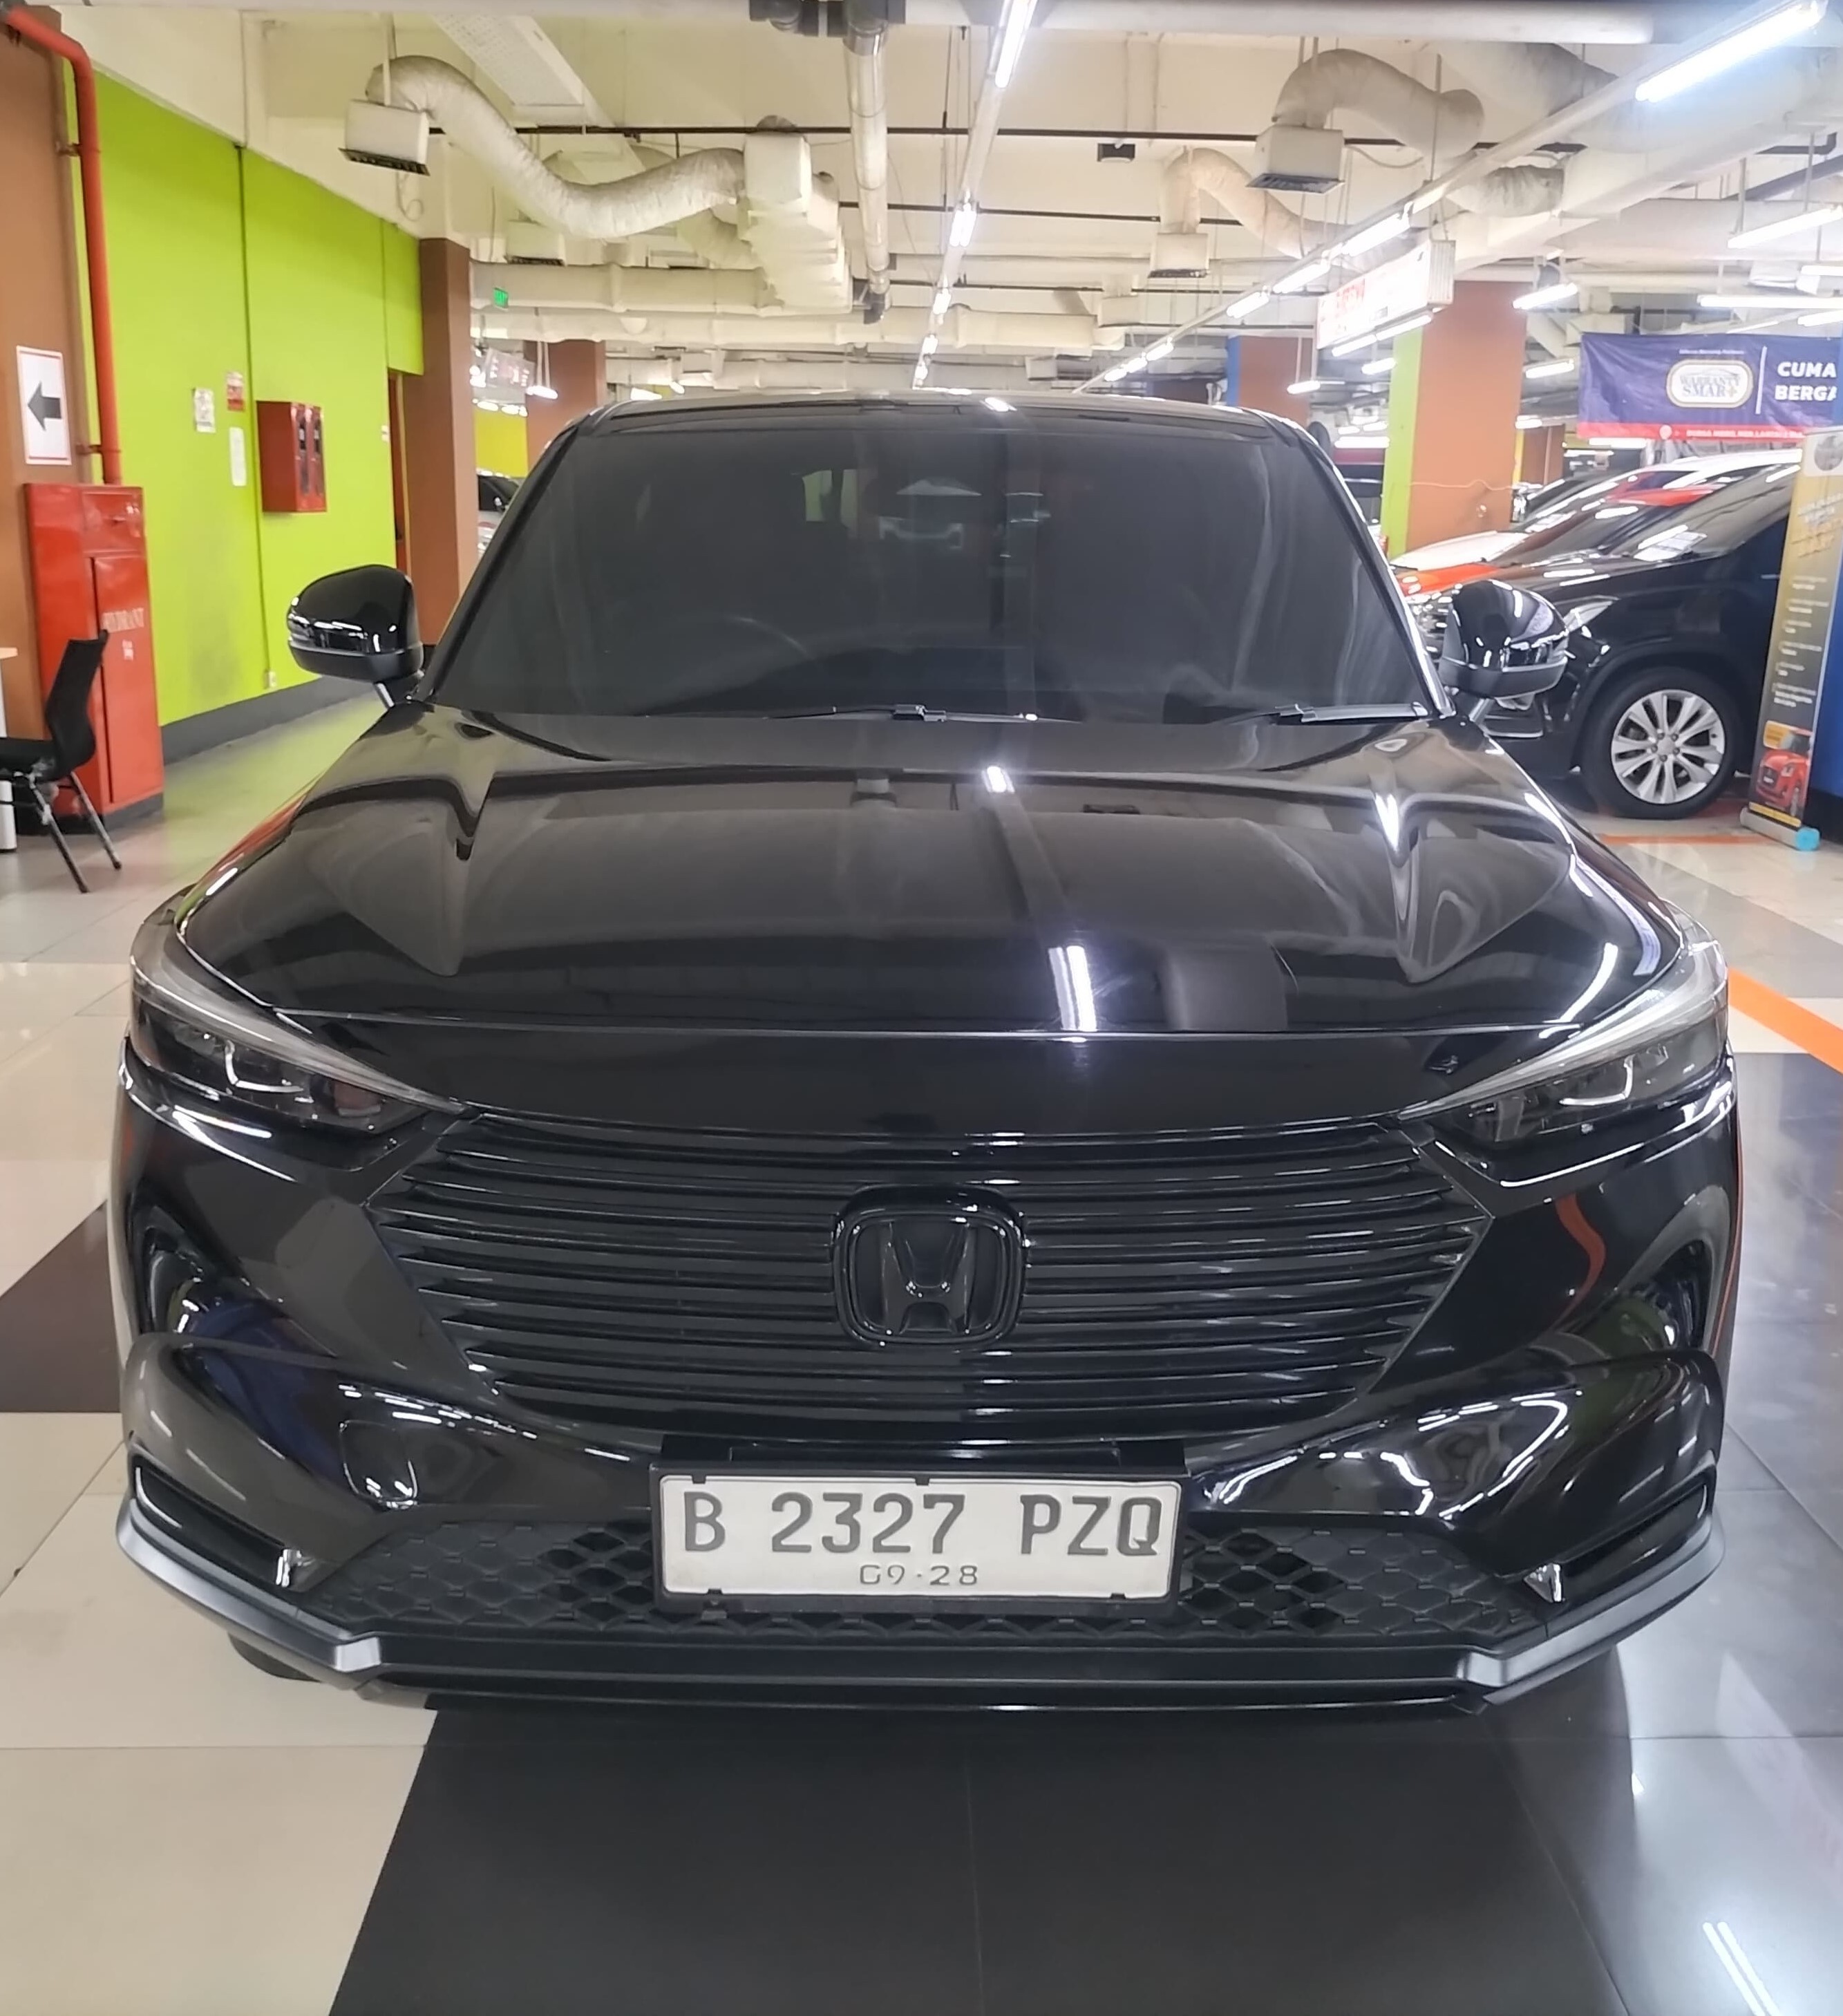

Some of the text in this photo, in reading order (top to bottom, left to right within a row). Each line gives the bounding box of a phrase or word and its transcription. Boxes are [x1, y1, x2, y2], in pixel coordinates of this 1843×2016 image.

[1777, 361, 1837, 378] CUMA
[683, 1491, 1162, 1556] B 2327 PZQ
